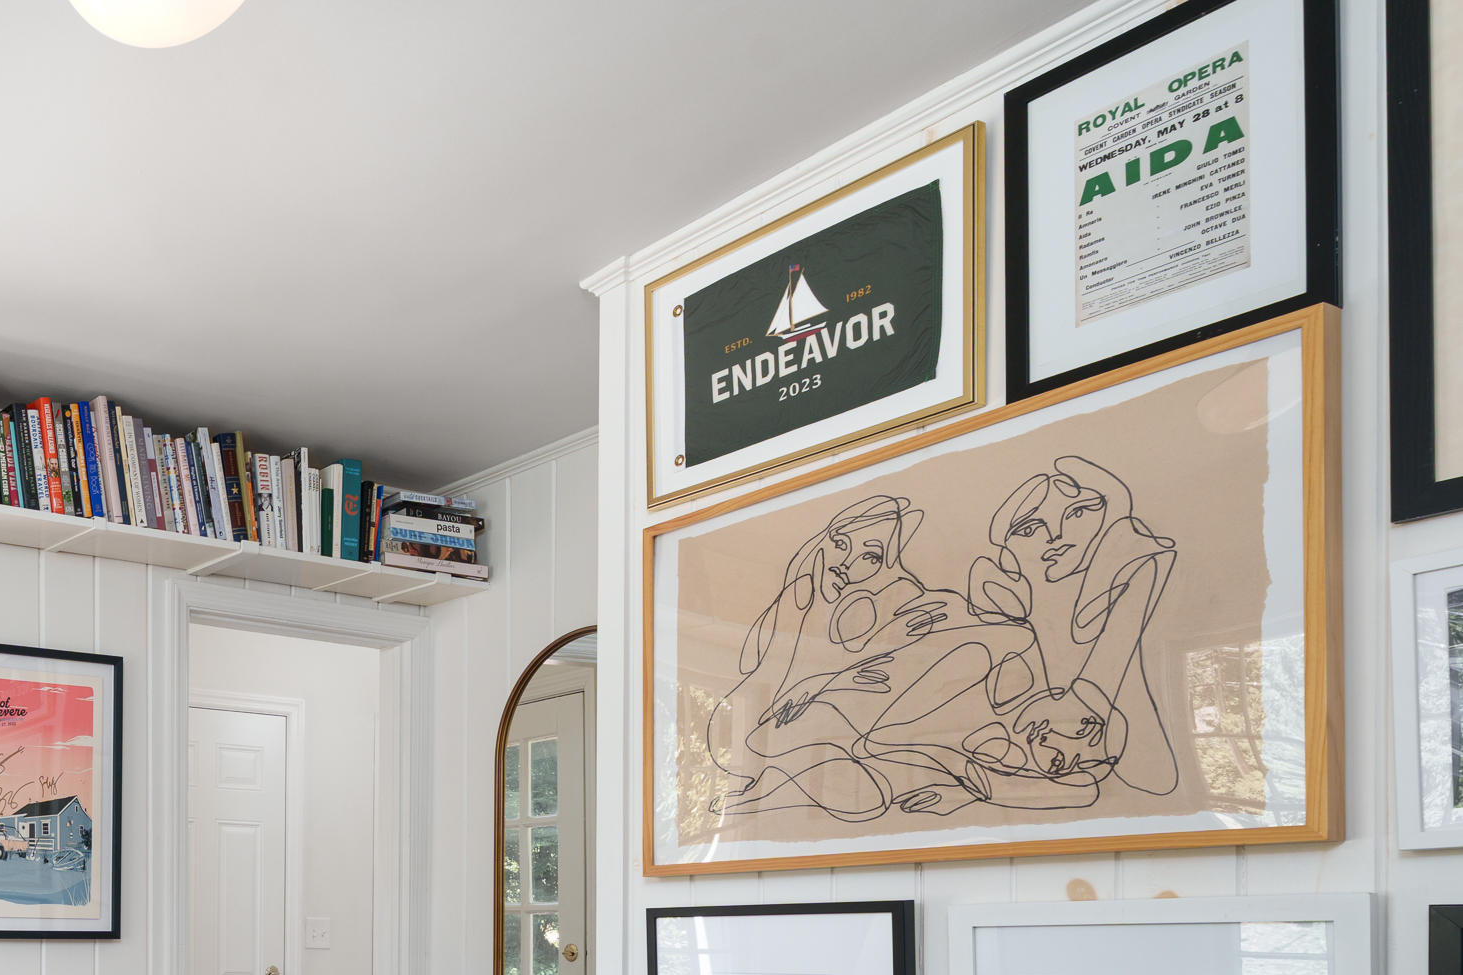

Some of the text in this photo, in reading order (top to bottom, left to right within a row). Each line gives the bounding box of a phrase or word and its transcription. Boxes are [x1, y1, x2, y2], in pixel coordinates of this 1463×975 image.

[1078, 50, 1244, 137] ROYAL OPERA
[1108, 81, 1210, 131] COVENT GARDEN
[1084, 141, 1108, 156] COVENT
[1112, 128, 1137, 143] GARDEN
[1142, 116, 1163, 130] OPERA
[1168, 97, 1204, 118] SYNDICATE
[1210, 82, 1236, 99] SEASON
[1157, 119, 1185, 138] MAY
[1192, 108, 1211, 123] 28
[1215, 100, 1229, 113] at
[1234, 93, 1244, 104] 8
[1078, 115, 1245, 207] AIDA
[1196, 146, 1245, 171] GIULIO TOMEI
[1152, 188, 1171, 200] IRENE
[1175, 174, 1205, 190] MINGHINI
[1210, 158, 1245, 176] CATTANEO
[1200, 169, 1245, 191] EVA TURNER
[1180, 180, 1246, 210] FRANCESCO MERLI
[1205, 192, 1246, 212] EZIO PINZA
[1078, 217, 1102, 230] Amneris
[1183, 204, 1243, 231] JOHN BROWNLEE
[1201, 213, 1246, 235] OCTAVE DUA
[1078, 232, 1092, 240] Aida
[1078, 237, 1105, 250] Radames
[1079, 250, 1099, 260] Ramfis
[1085, 229, 1240, 290] Conductor VINCENZO BELLEZZA
[845, 284, 873, 302] 1982
[710, 302, 896, 404] ENDEAVOR
[724, 337, 753, 354] ESTD.
[778, 374, 822, 402] 2023
[44, 404, 52, 429] VEGETABLES
[30, 415, 38, 449] BOURDAIN
[0, 453, 7, 480] AMERICAN
[130, 454, 139, 481] COMPANY
[258, 456, 270, 491] ROBIN
[134, 482, 140, 490] OF
[135, 491, 143, 513] WOMEN
[436, 523, 461, 533] pasta
[438, 513, 462, 523] BAYOU
[390, 527, 475, 550] SURF SHACK
[0, 697, 11, 708] of
